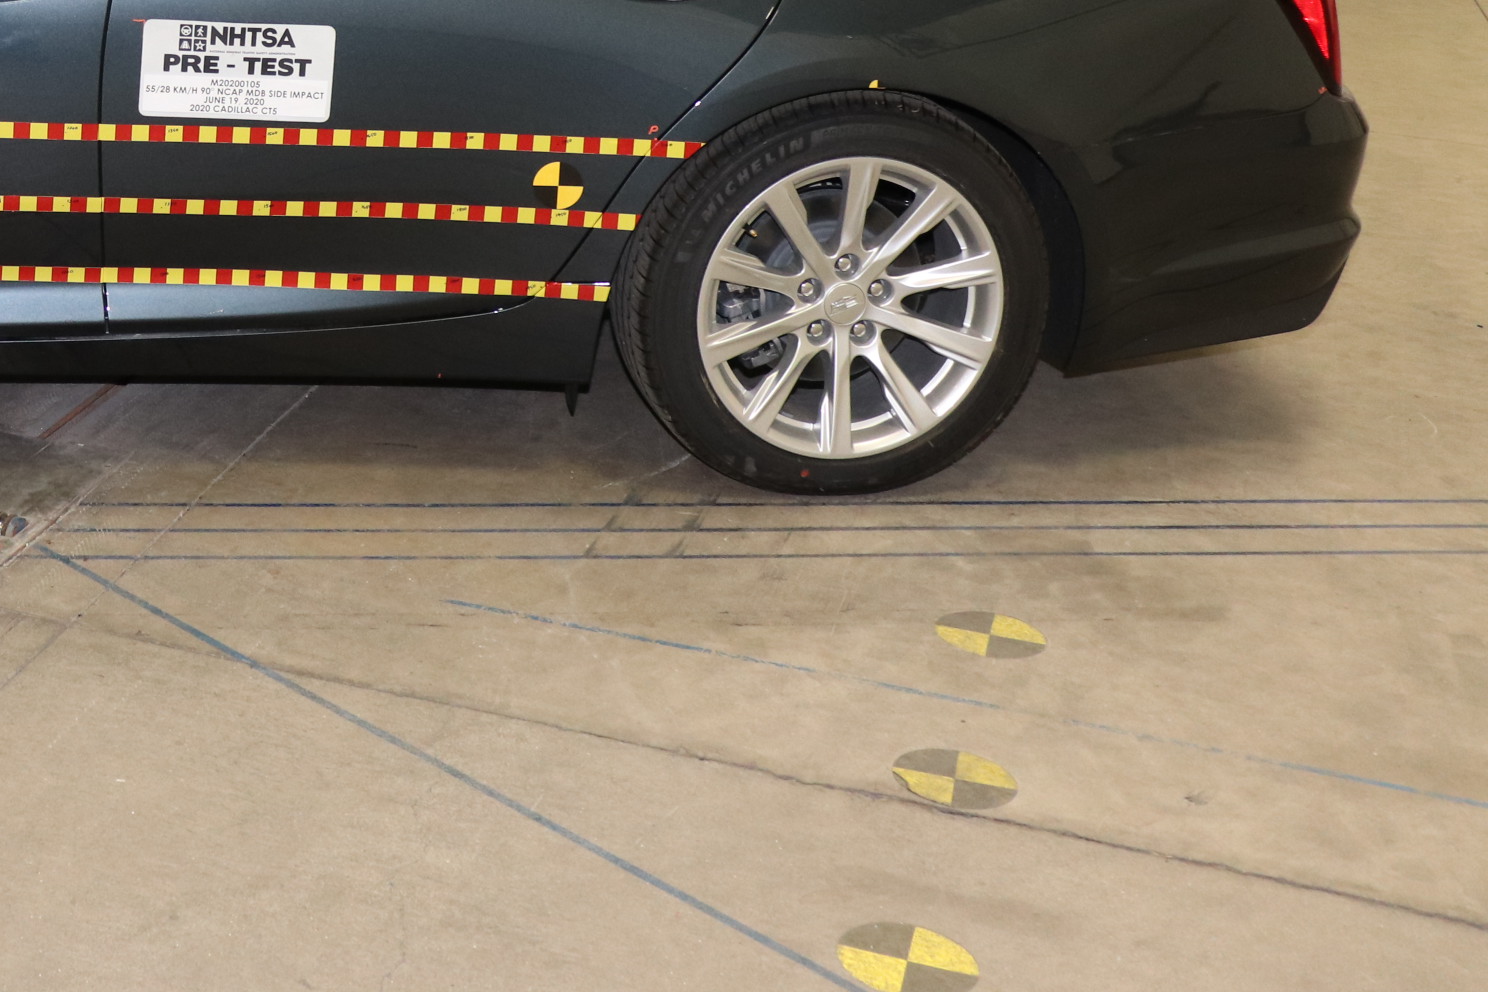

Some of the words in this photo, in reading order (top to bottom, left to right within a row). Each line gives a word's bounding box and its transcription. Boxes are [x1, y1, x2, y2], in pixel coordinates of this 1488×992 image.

[210, 25, 296, 49] NHTSA
[163, 53, 220, 74] PRE
[243, 56, 312, 77] TEST
[145, 84, 171, 94] 55/28
[173, 85, 198, 95] KM/H
[217, 88, 244, 97] NCAP
[246, 89, 266, 98] MDB
[268, 90, 288, 99] SIDE
[289, 91, 325, 100] IMPACT
[210, 79, 261, 89] M20200105
[203, 96, 226, 105] JUNE
[243, 98, 265, 106] 2020
[189, 104, 211, 113] 2020
[213, 105, 258, 115] CADILLAC
[260, 106, 278, 116] CT5
[702, 137, 805, 223] MICHELIN
